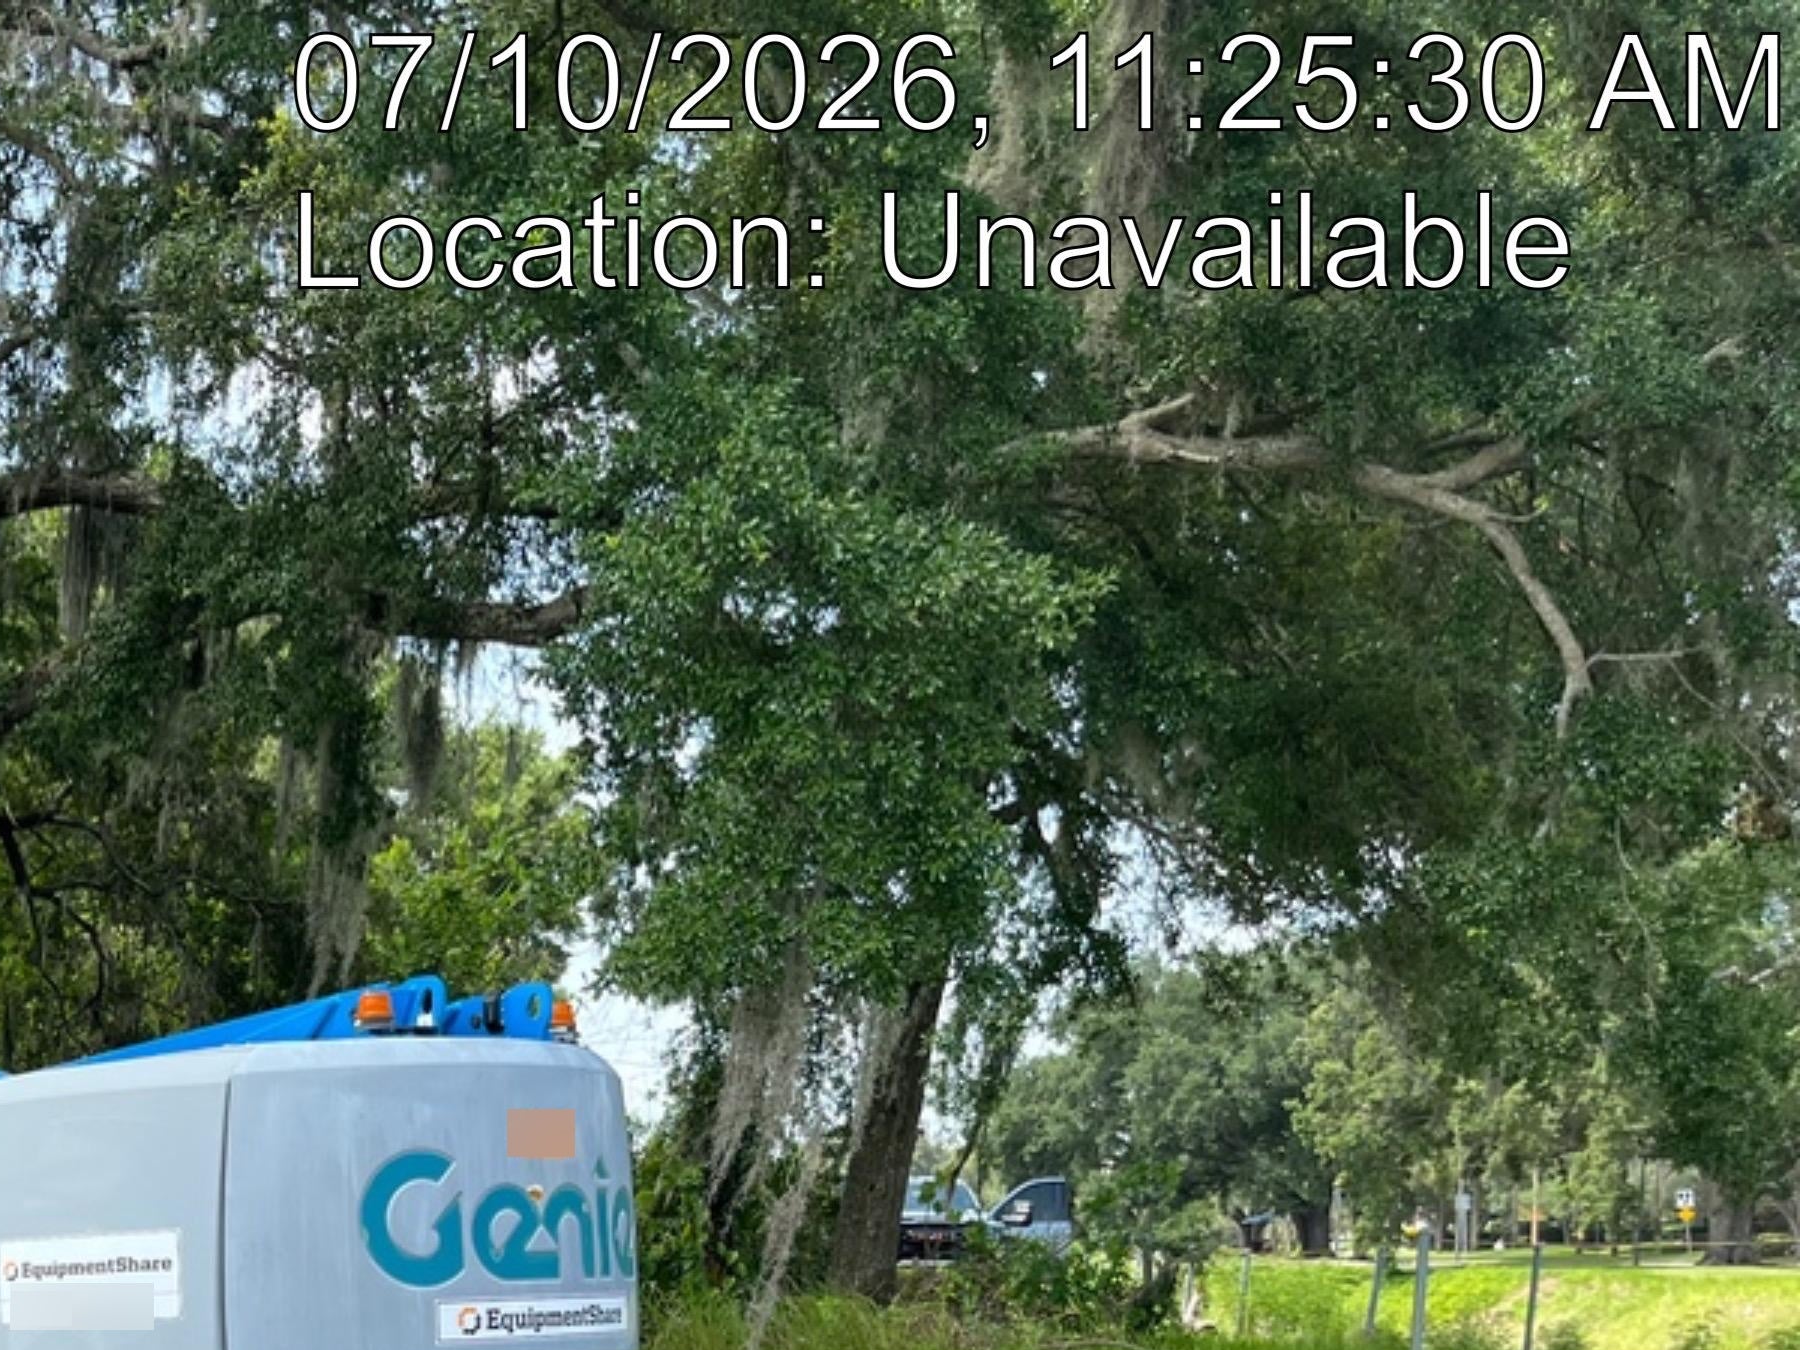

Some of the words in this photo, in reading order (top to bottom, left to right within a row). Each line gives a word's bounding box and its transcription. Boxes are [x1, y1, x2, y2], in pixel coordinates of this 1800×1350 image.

[359, 1148, 634, 1288] Genie
[21, 1254, 174, 1281] EquipmentShare
[485, 1303, 623, 1334] EquipmentShare
